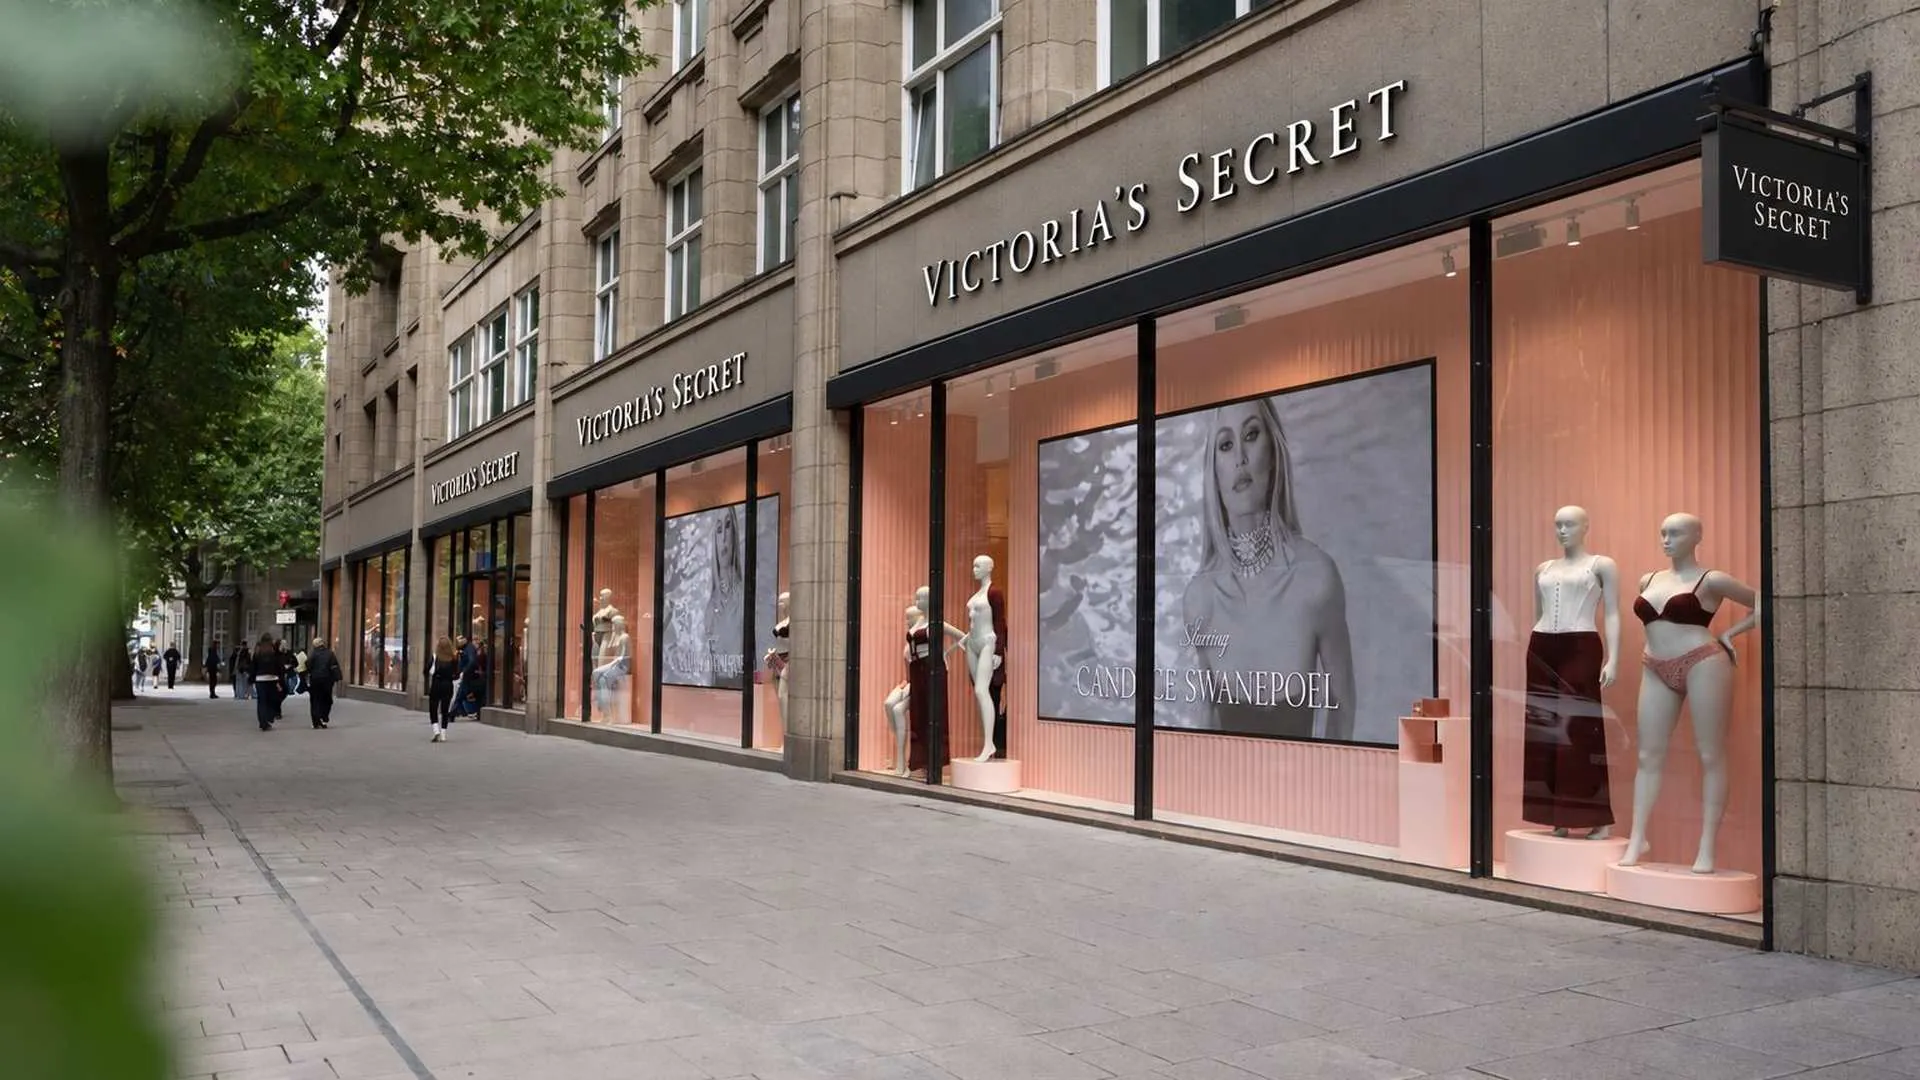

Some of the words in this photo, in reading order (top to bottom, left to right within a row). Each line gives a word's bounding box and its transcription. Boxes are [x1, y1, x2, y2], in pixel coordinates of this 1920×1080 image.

[922, 183, 1149, 307] VICTORIA'S
[1176, 79, 1408, 214] SECRET
[1732, 164, 1849, 216] VICTORIA'S
[1753, 201, 1831, 241] SECRET
[576, 385, 665, 447] VICTORIA'S
[671, 351, 748, 410] SECRET
[479, 450, 520, 487] SECRET
[1076, 665, 1177, 701] CANDCE
[1185, 668, 1339, 709] SWANEPOEL
